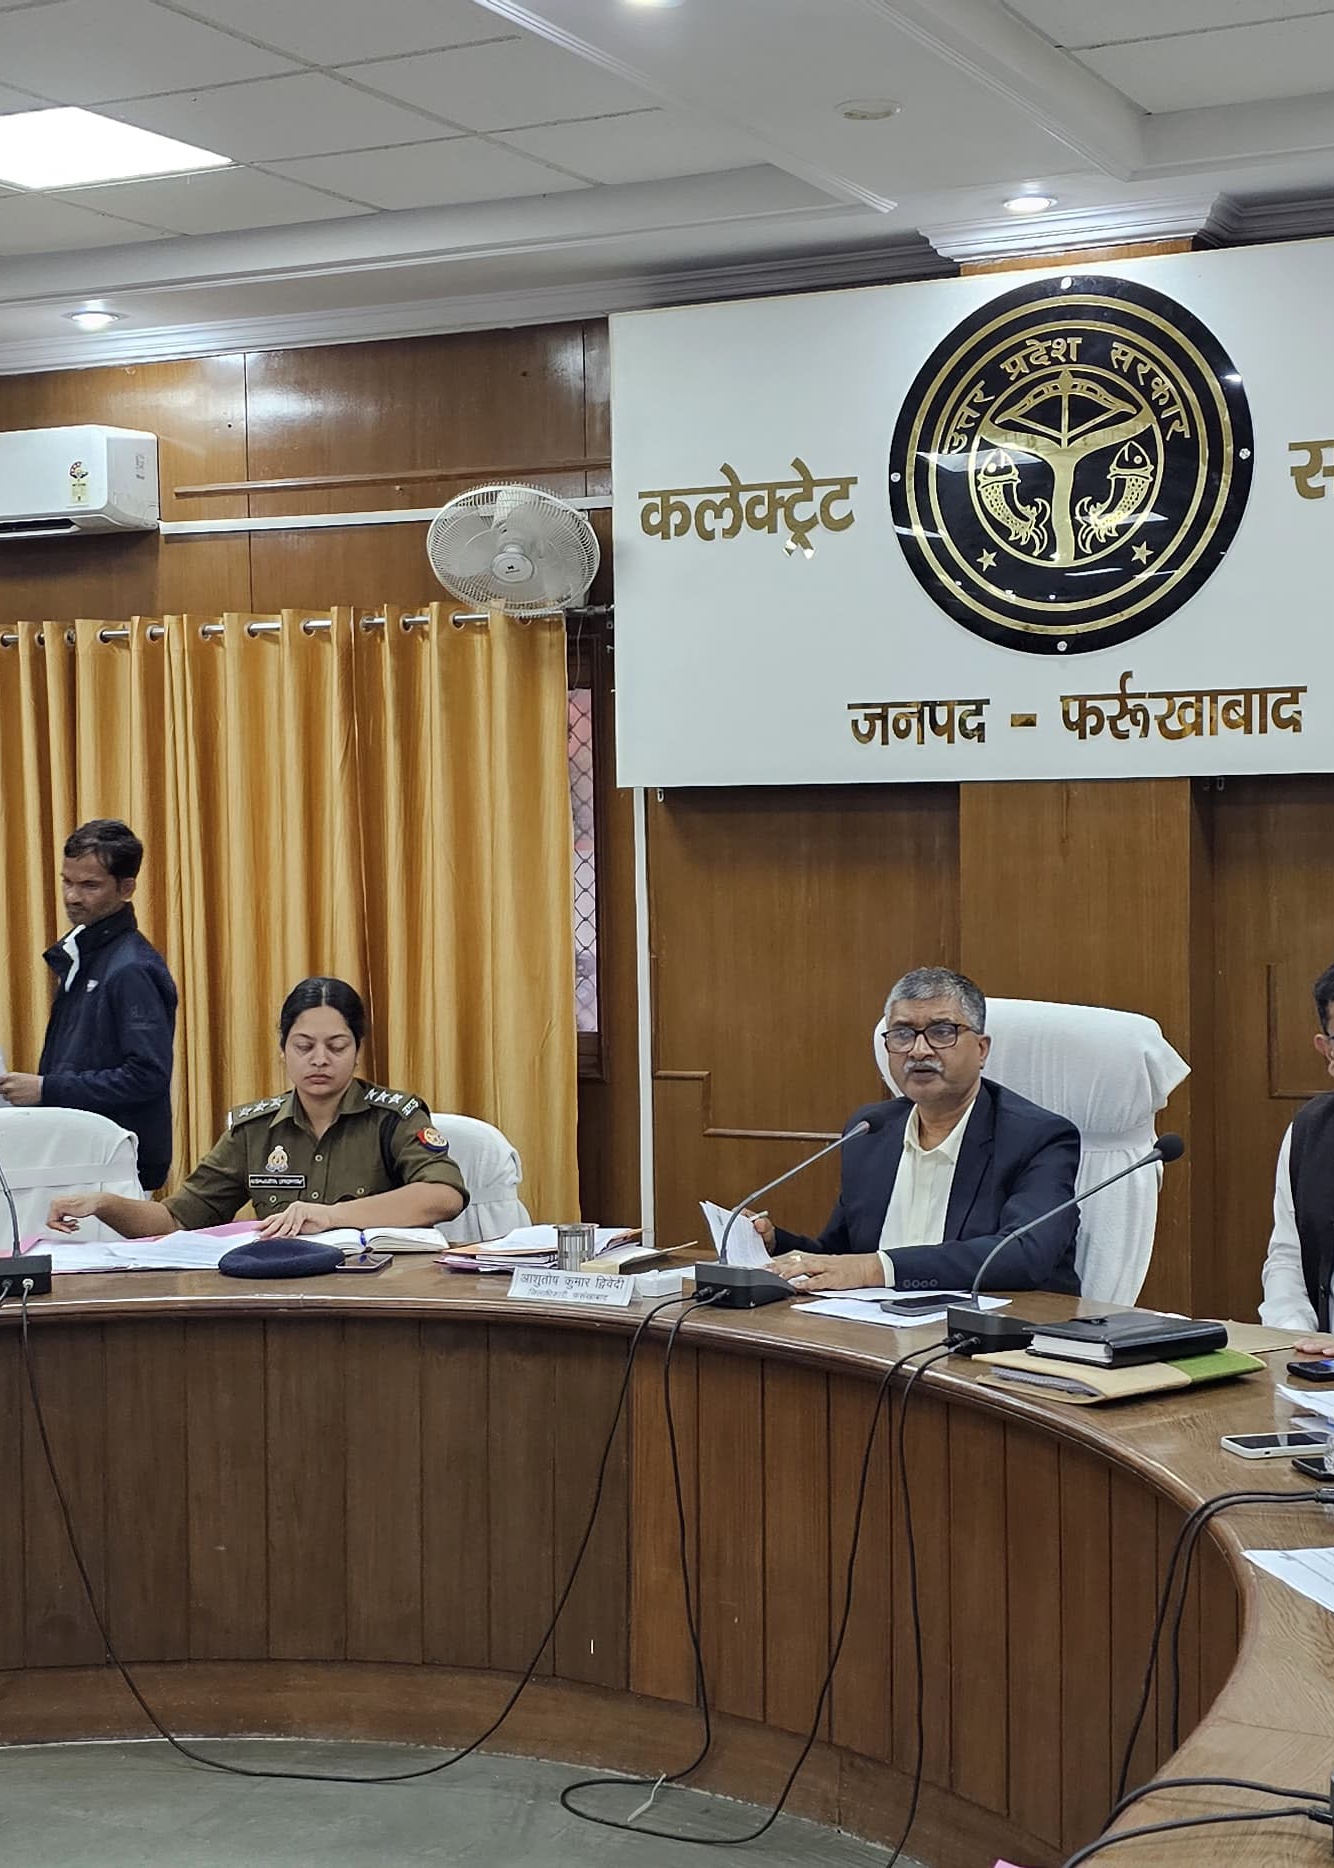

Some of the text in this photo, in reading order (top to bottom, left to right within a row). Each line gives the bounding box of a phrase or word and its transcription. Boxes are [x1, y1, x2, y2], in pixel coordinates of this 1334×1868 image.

[942, 337, 1191, 455] उत्तर प्रदेश सरकार
[638, 457, 859, 560] कलेक्ट्रेट
[847, 698, 990, 746] जनपद
[1060, 671, 1307, 740] फर्रूखाबाद
[565, 1275, 591, 1290] कुमार
[595, 1274, 625, 1291] द्विवेदी
